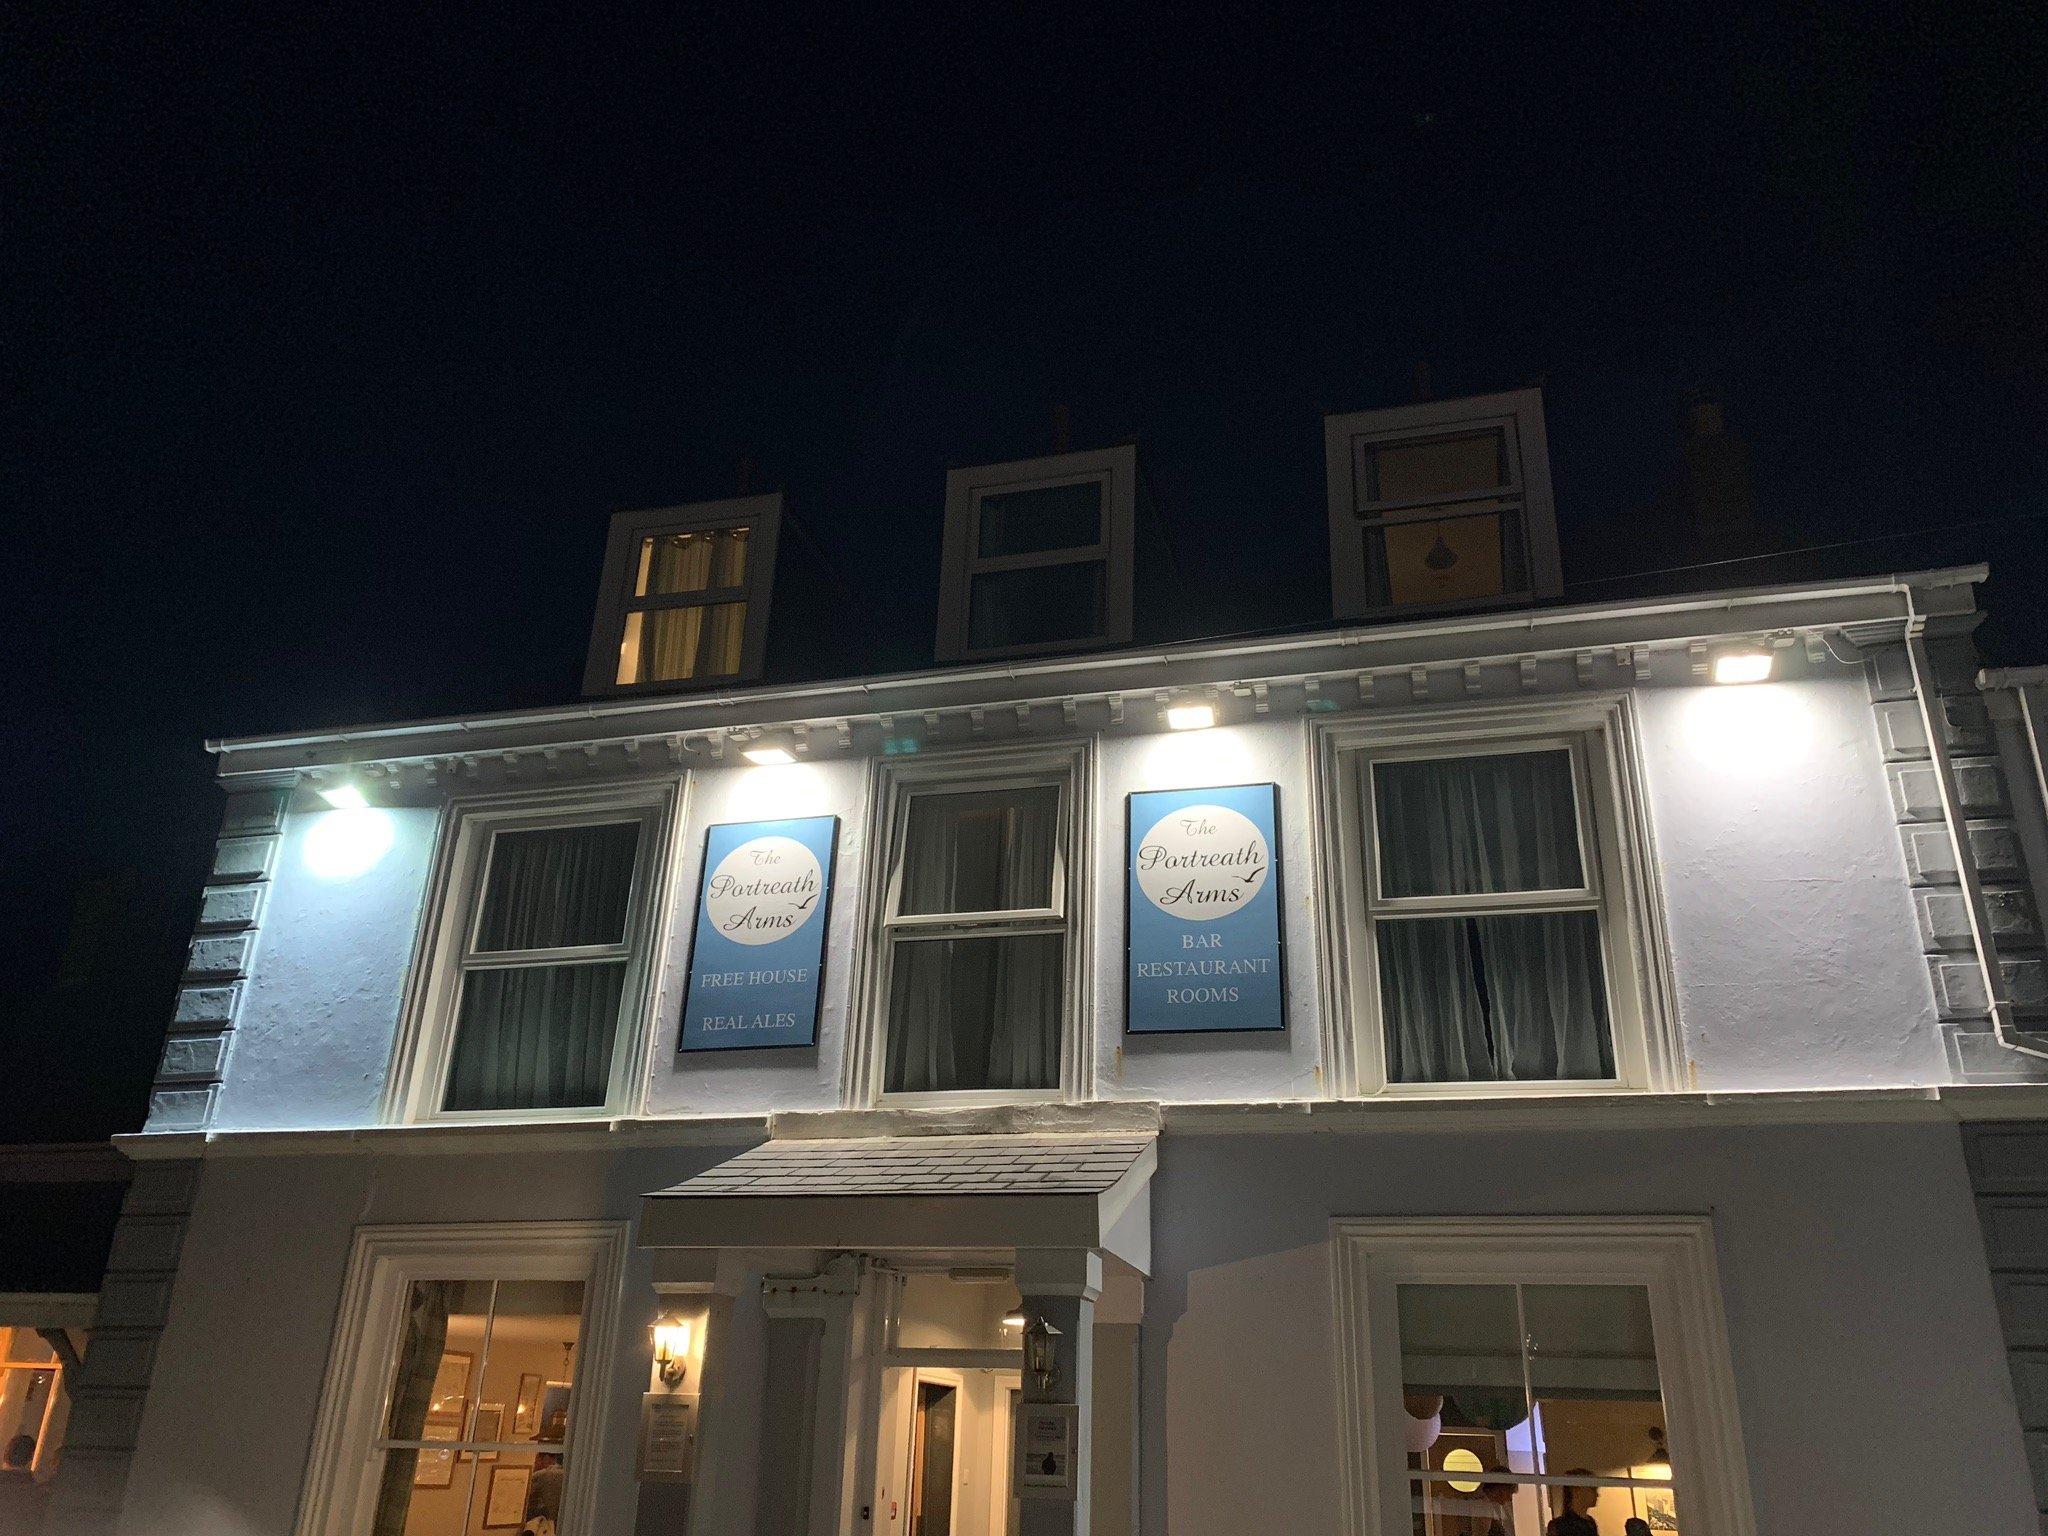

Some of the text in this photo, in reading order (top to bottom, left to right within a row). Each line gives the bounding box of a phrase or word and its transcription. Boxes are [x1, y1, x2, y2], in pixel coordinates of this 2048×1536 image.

[1180, 819, 1216, 836] The
[750, 849, 782, 865] The
[1139, 840, 1262, 871] Portreath
[710, 869, 817, 899] Portreath
[1159, 878, 1244, 905] Arms
[723, 906, 794, 931] Arms
[1182, 934, 1222, 949] BAR
[701, 968, 808, 988] FREE HOUSE
[1137, 958, 1271, 978] RESTAURANT
[1167, 987, 1239, 1004] ROOMS
[702, 1013, 796, 1031] REAL ALES
